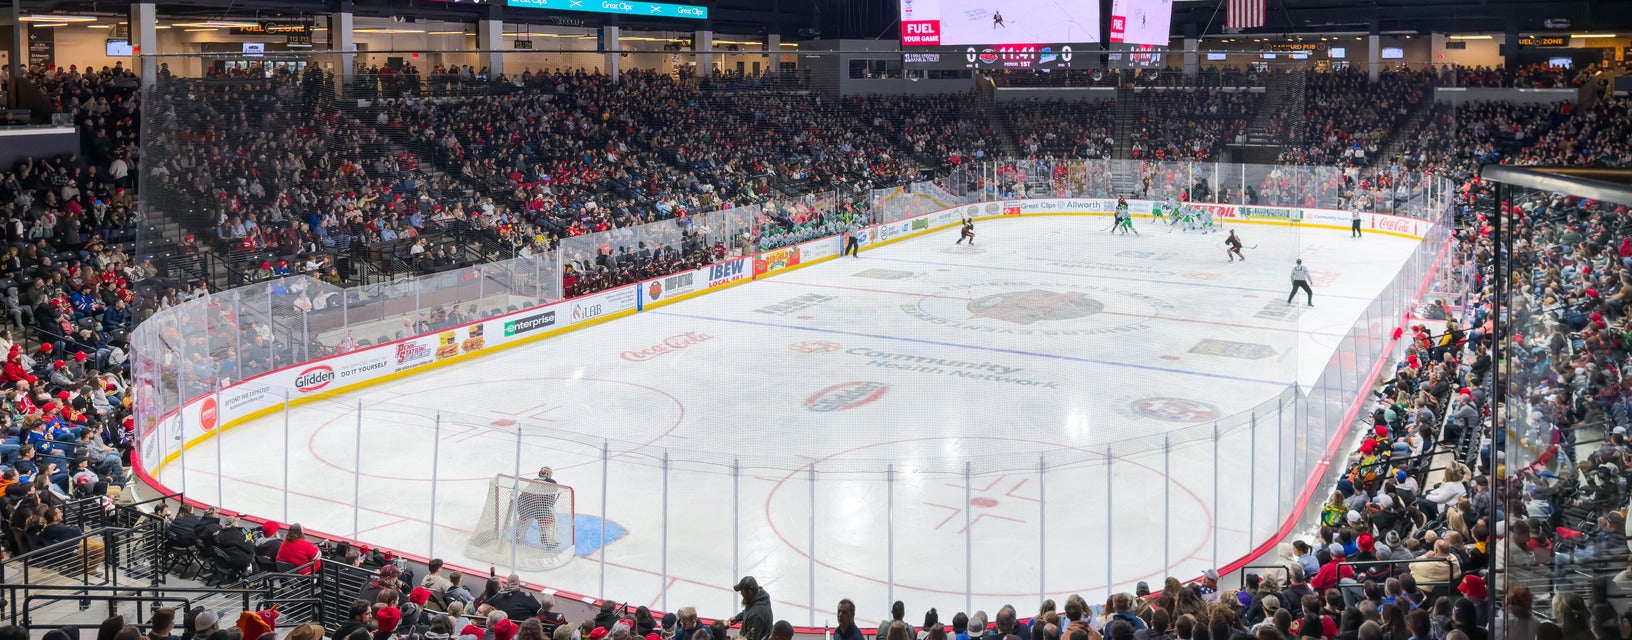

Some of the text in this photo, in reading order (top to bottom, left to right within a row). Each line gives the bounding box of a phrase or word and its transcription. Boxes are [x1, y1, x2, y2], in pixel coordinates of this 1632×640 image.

[601, 1, 633, 11] Great Clips
[907, 24, 935, 34] FUEL
[966, 45, 1072, 63] 0 11:41 0
[1040, 202, 1056, 210] Clips
[1066, 201, 1101, 209] Allworth
[1217, 206, 1236, 218] OIL
[709, 258, 745, 281] IBEW
[708, 279, 730, 288] LOCAL
[581, 304, 602, 319] iLAB
[507, 314, 555, 333] enterprise
[845, 347, 1025, 375] Community
[341, 370, 350, 378] DO
[359, 361, 388, 374] YOURSELF
[866, 359, 1060, 390] Health Network
[295, 371, 335, 388] Glidden
